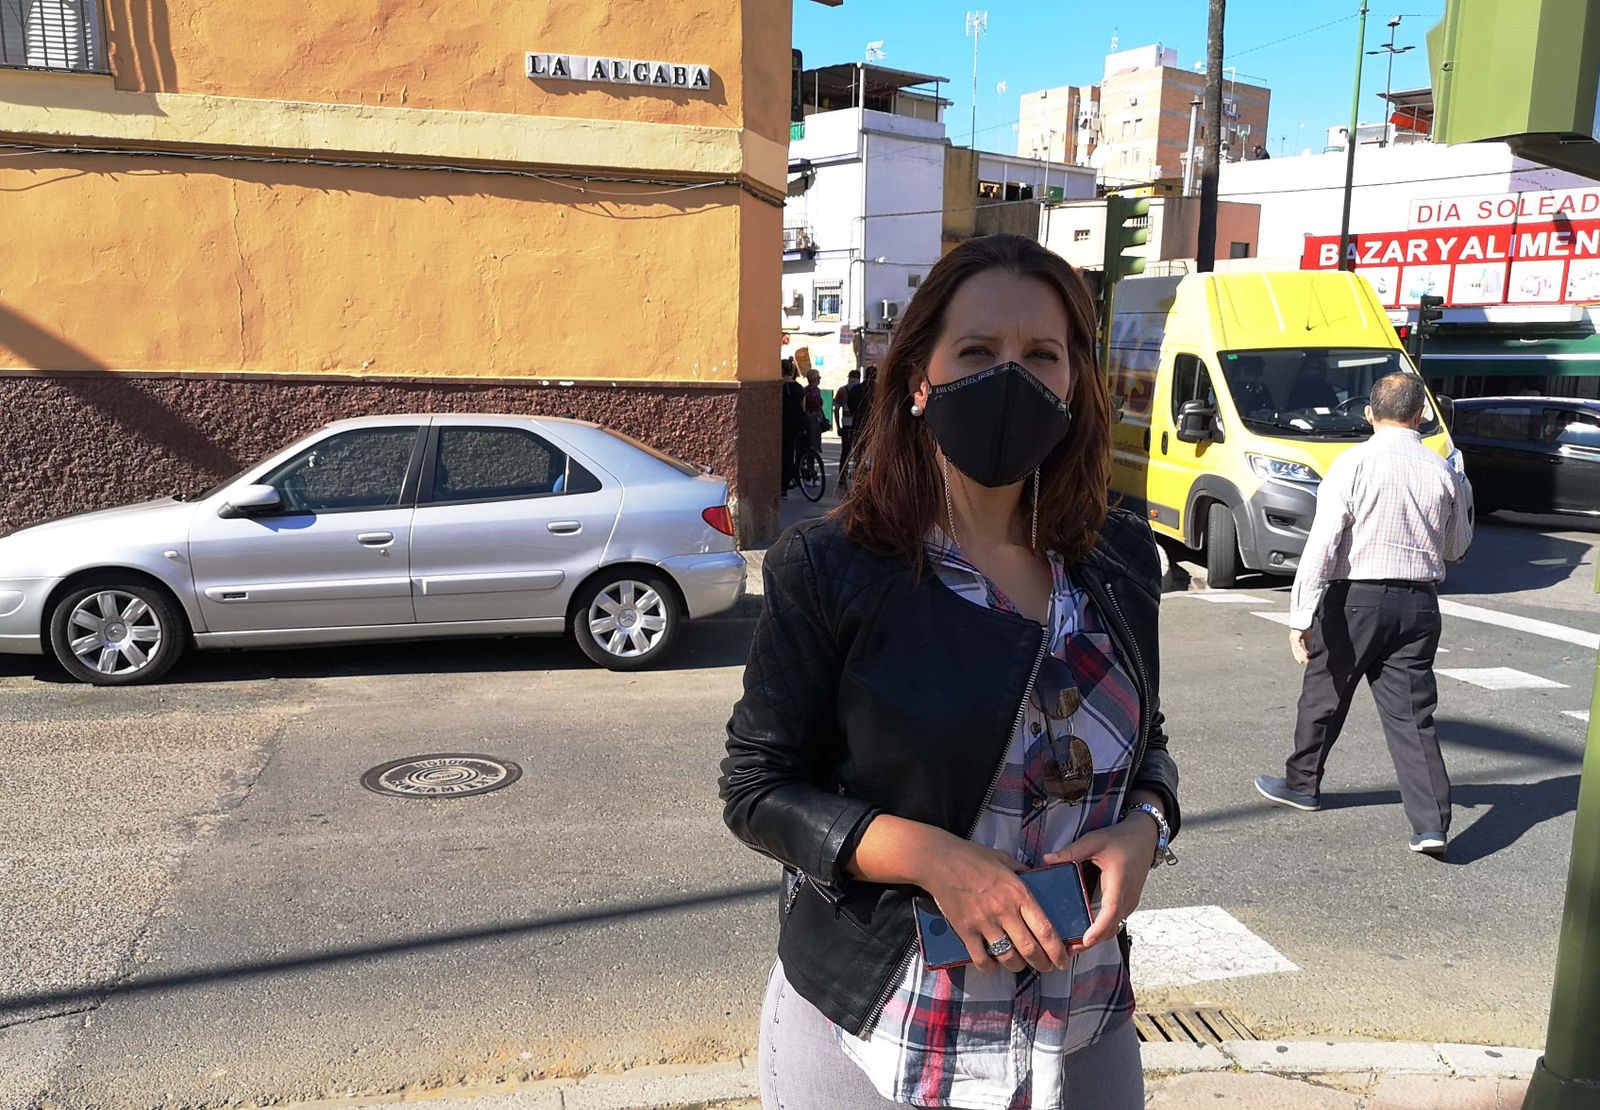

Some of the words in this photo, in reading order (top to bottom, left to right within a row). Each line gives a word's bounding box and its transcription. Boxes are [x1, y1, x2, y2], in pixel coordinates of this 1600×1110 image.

[529, 54, 568, 76] LA
[591, 59, 708, 87] ALGABA
[1477, 193, 1600, 220] SOLEAD
